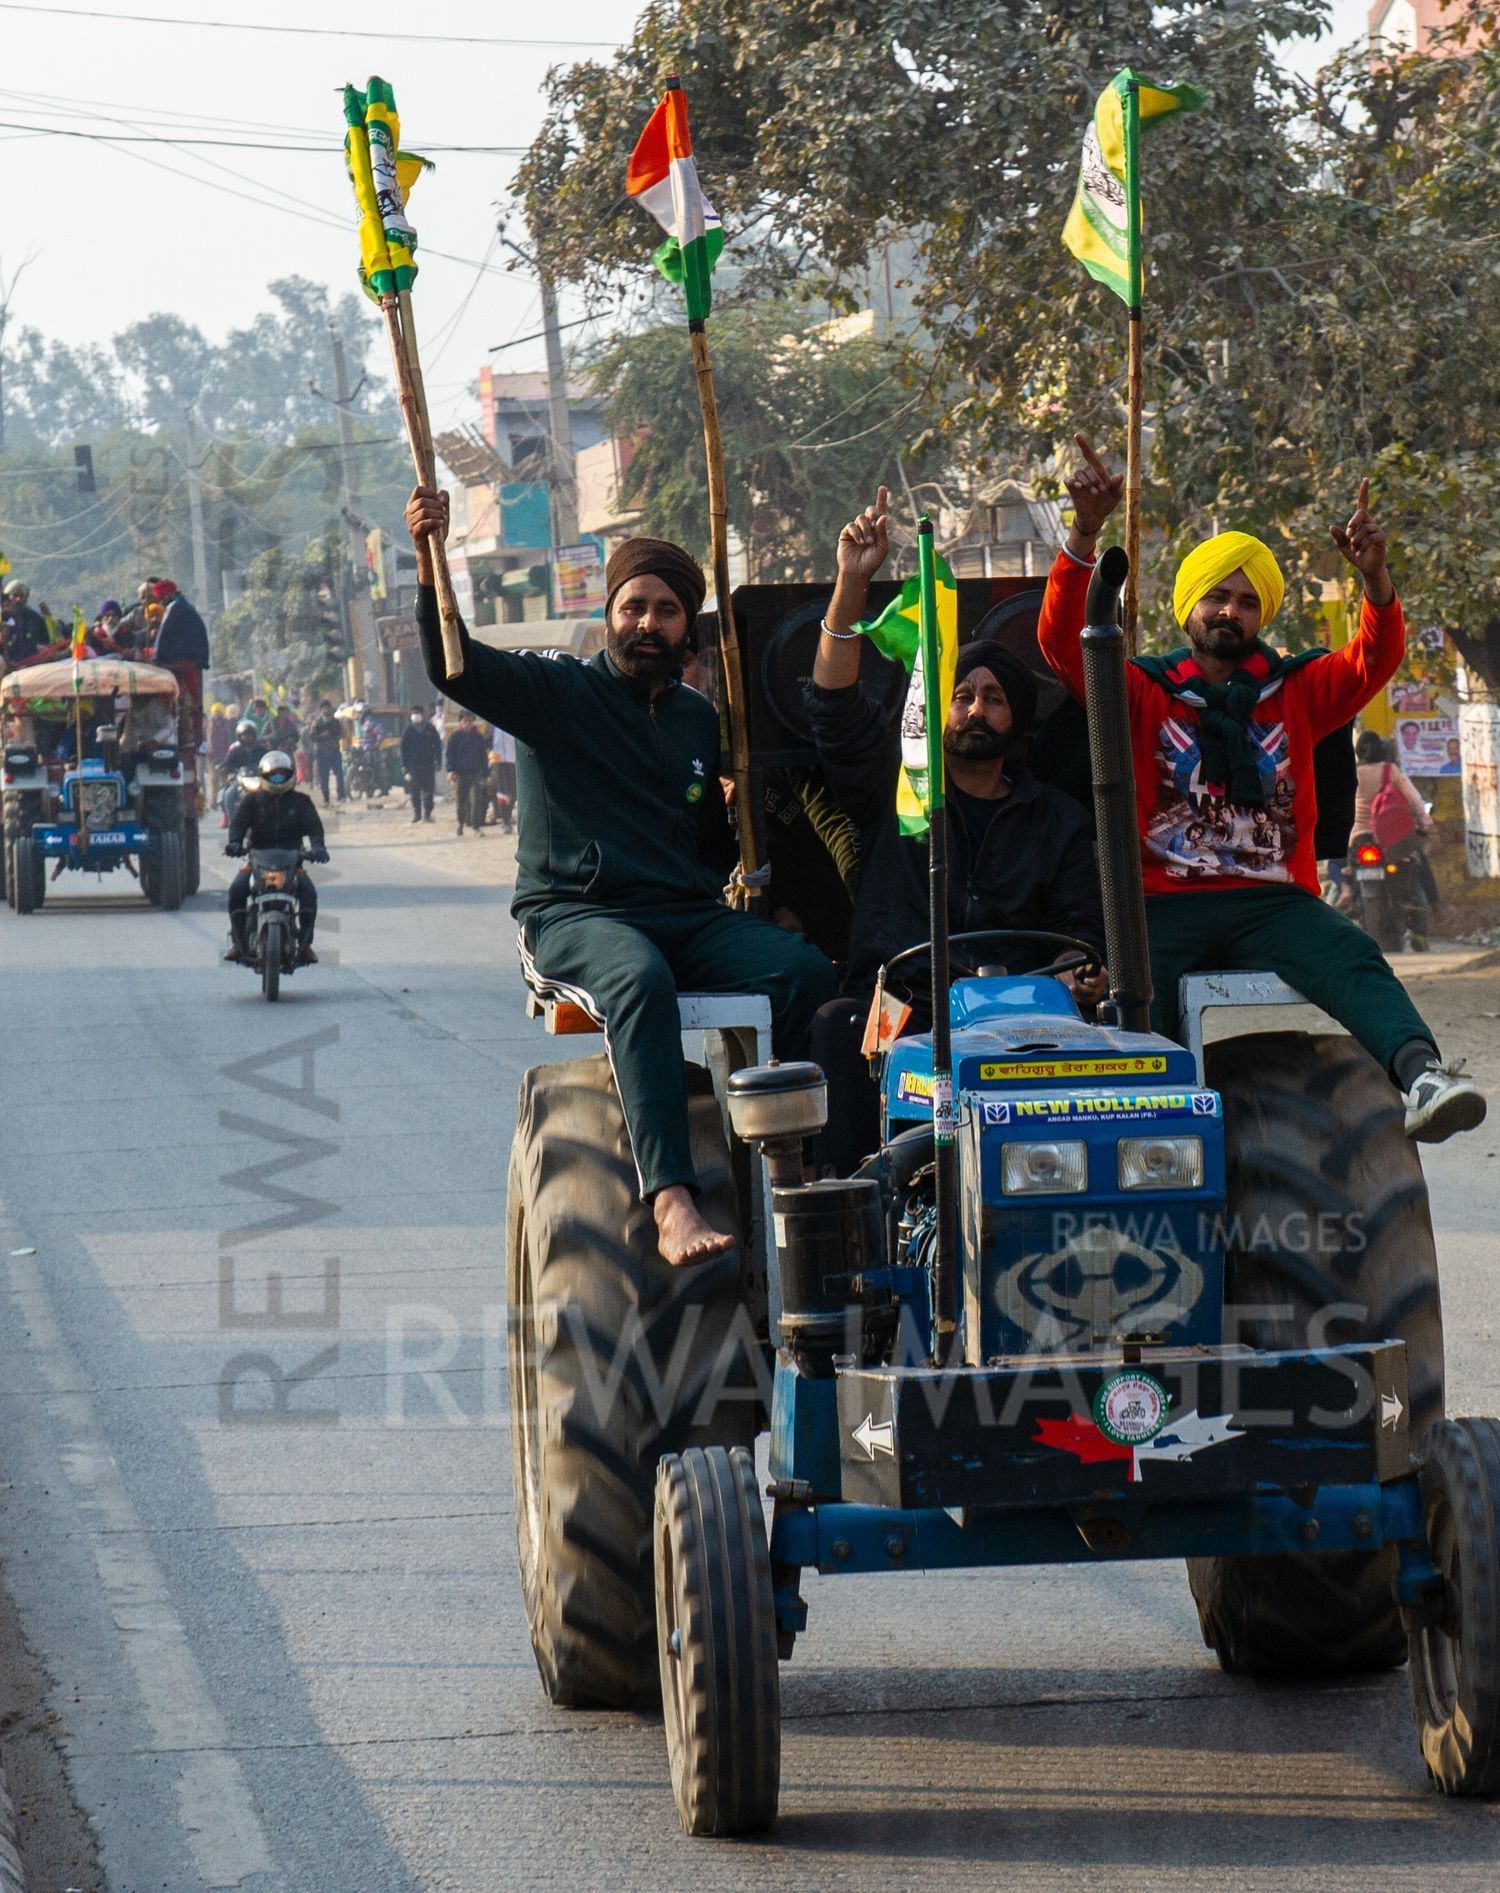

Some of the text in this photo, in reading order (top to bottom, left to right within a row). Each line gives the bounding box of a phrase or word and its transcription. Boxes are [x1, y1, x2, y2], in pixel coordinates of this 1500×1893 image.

[1015, 1094, 1186, 1116] NEW HOLLAND
[1047, 1115, 1071, 1123] ANGAD
[1072, 1114, 1100, 1122] MANKU,
[1108, 1374, 1140, 1390] SUPPORT
